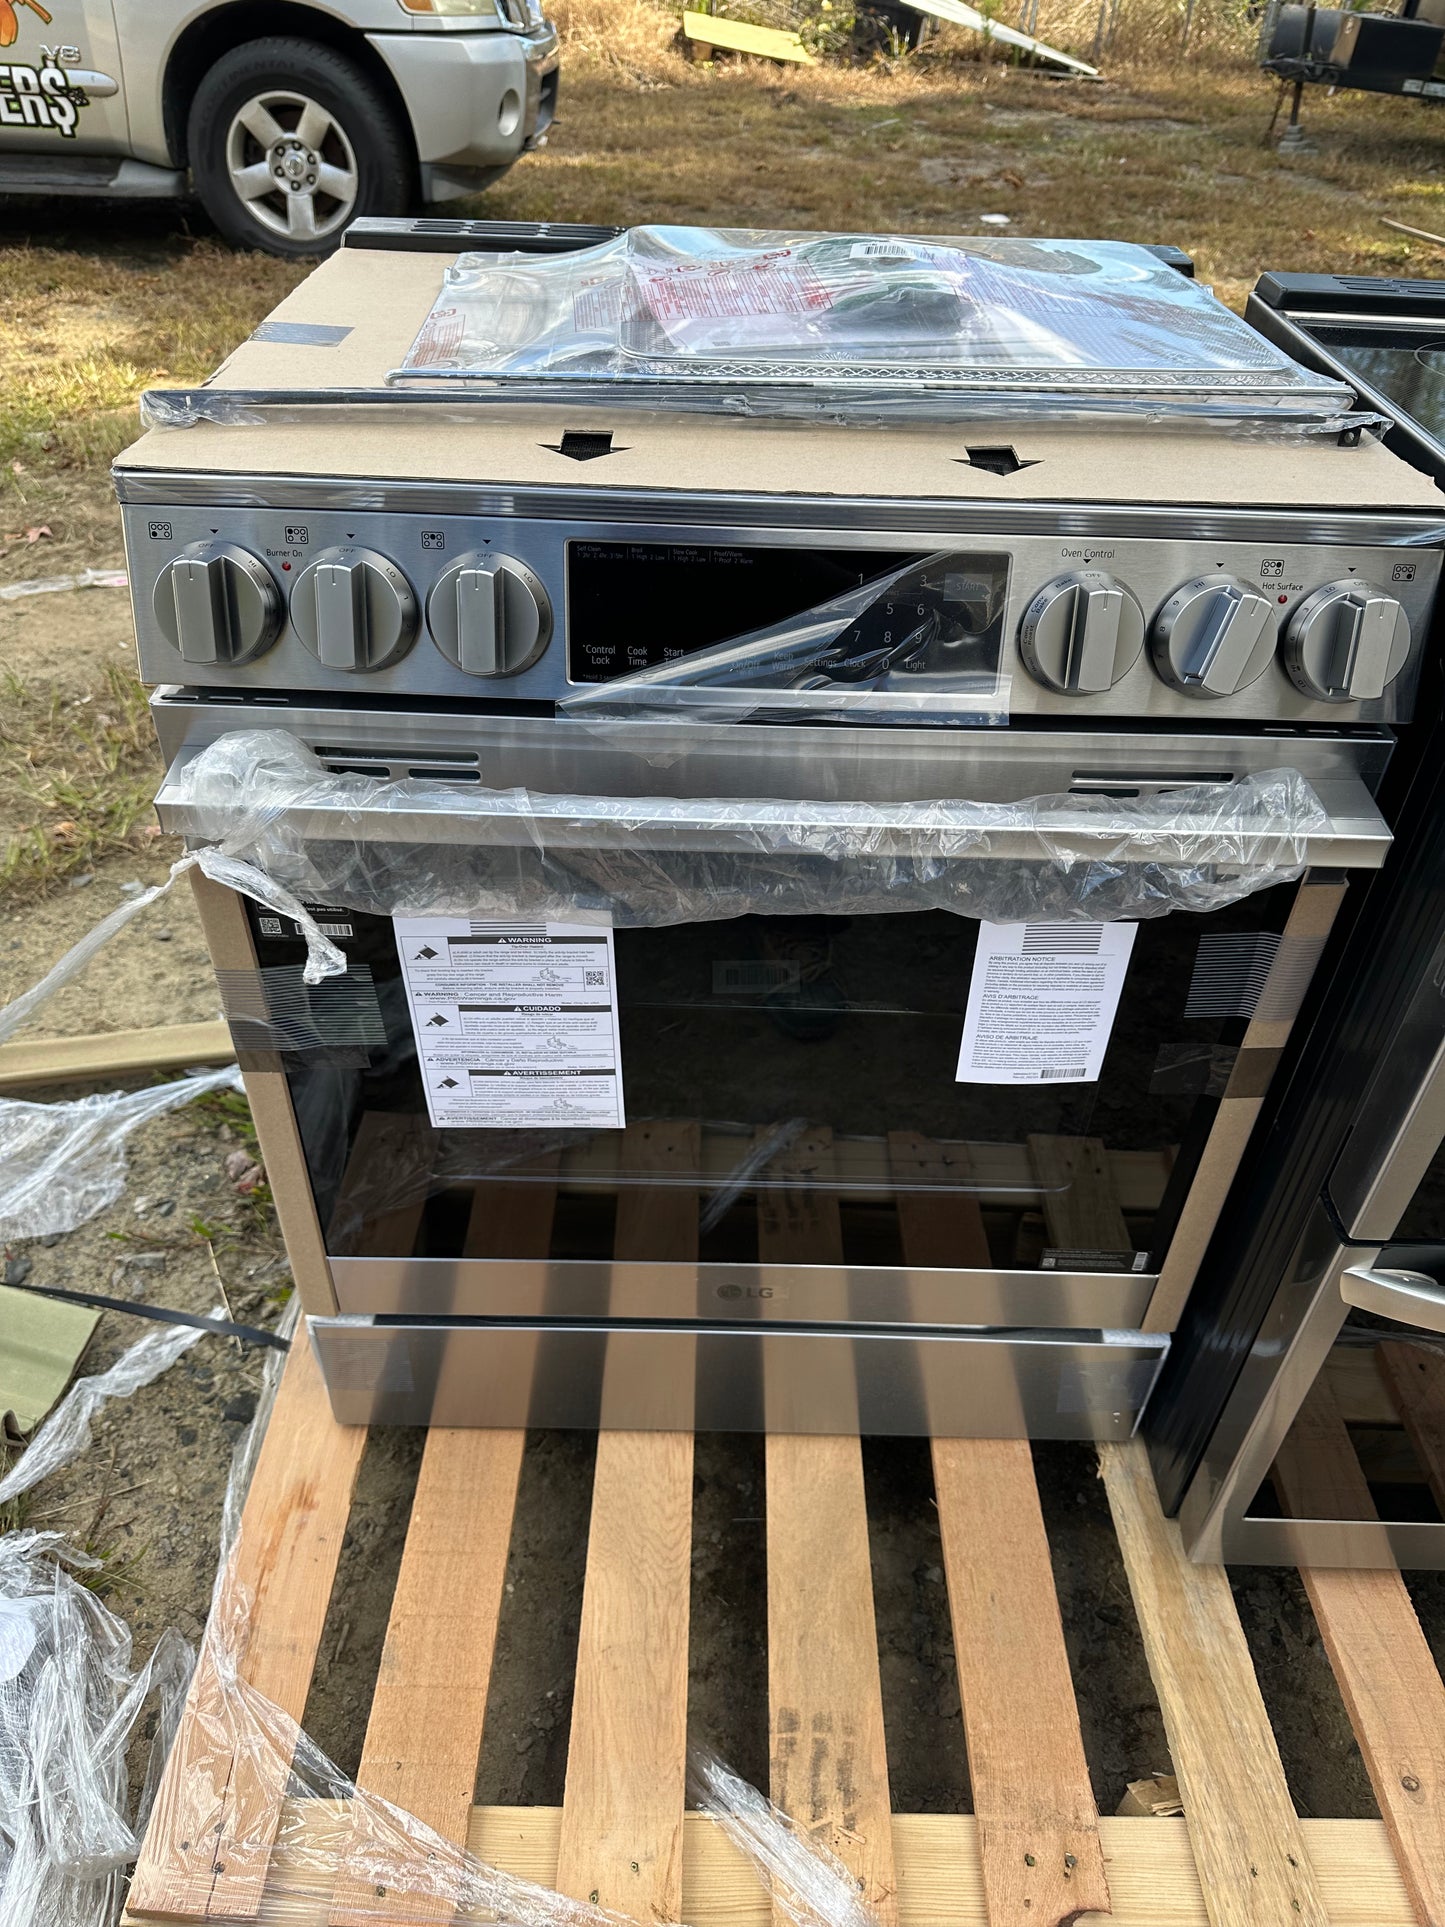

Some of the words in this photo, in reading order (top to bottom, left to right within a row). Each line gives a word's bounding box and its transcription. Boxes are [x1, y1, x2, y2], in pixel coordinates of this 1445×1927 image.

[266, 548, 290, 558] Burner
[292, 549, 303, 557] On
[1061, 547, 1082, 559] Oven
[1084, 547, 1115, 560] Control
[858, 573, 863, 585] 1
[920, 575, 928, 587] 3
[1055, 578, 1073, 589] Bake
[956, 583, 979, 592] START
[1262, 582, 1275, 590] Hot
[1277, 582, 1304, 592] Surface
[886, 603, 893, 615] 5
[917, 603, 924, 616] 6
[854, 630, 861, 642] 7
[884, 631, 891, 643] 8
[915, 631, 922, 644] 9
[585, 644, 617, 655] Control
[627, 646, 648, 656] Cook
[663, 647, 684, 657] Start
[591, 655, 610, 665] Lock
[628, 656, 647, 666] Time
[805, 657, 837, 669] Settings
[844, 657, 866, 668] Clock
[881, 659, 889, 670] 0
[905, 659, 926, 671] Light
[747, 1287, 773, 1298] LG
